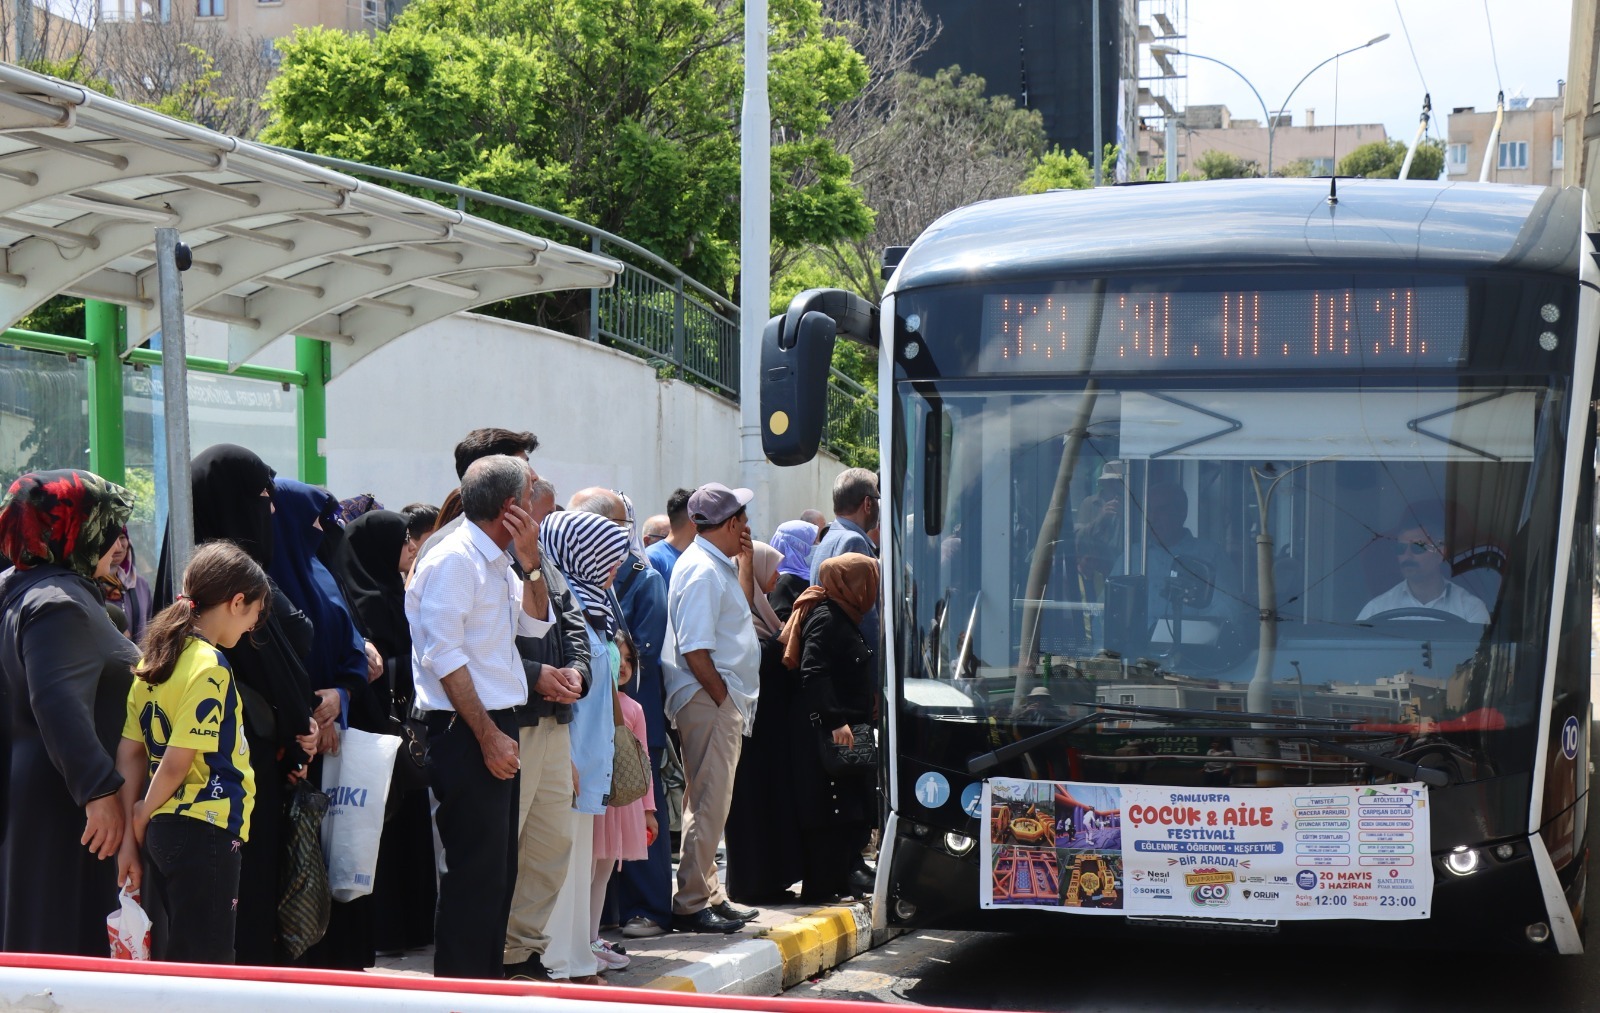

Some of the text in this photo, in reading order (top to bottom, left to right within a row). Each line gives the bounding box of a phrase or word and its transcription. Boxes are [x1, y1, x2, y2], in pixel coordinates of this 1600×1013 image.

[1566, 725, 1578, 751] 10
[1170, 794, 1230, 805] ŞANLIURFA
[1128, 802, 1274, 829] ÇOCUK & AİLE
[1167, 826, 1236, 840] FESTİVALİ
[1141, 842, 1276, 854] EĞLENME ÖĞRENME KEŞFETME
[1179, 854, 1239, 868] BİR ARADA!
[1320, 872, 1372, 881] 20 MAYIS
[1320, 880, 1372, 890] 3 HAZİRAN
[1200, 886, 1226, 898] GO
[1314, 895, 1348, 906] 12:00
[1380, 896, 1416, 907] 23:00
